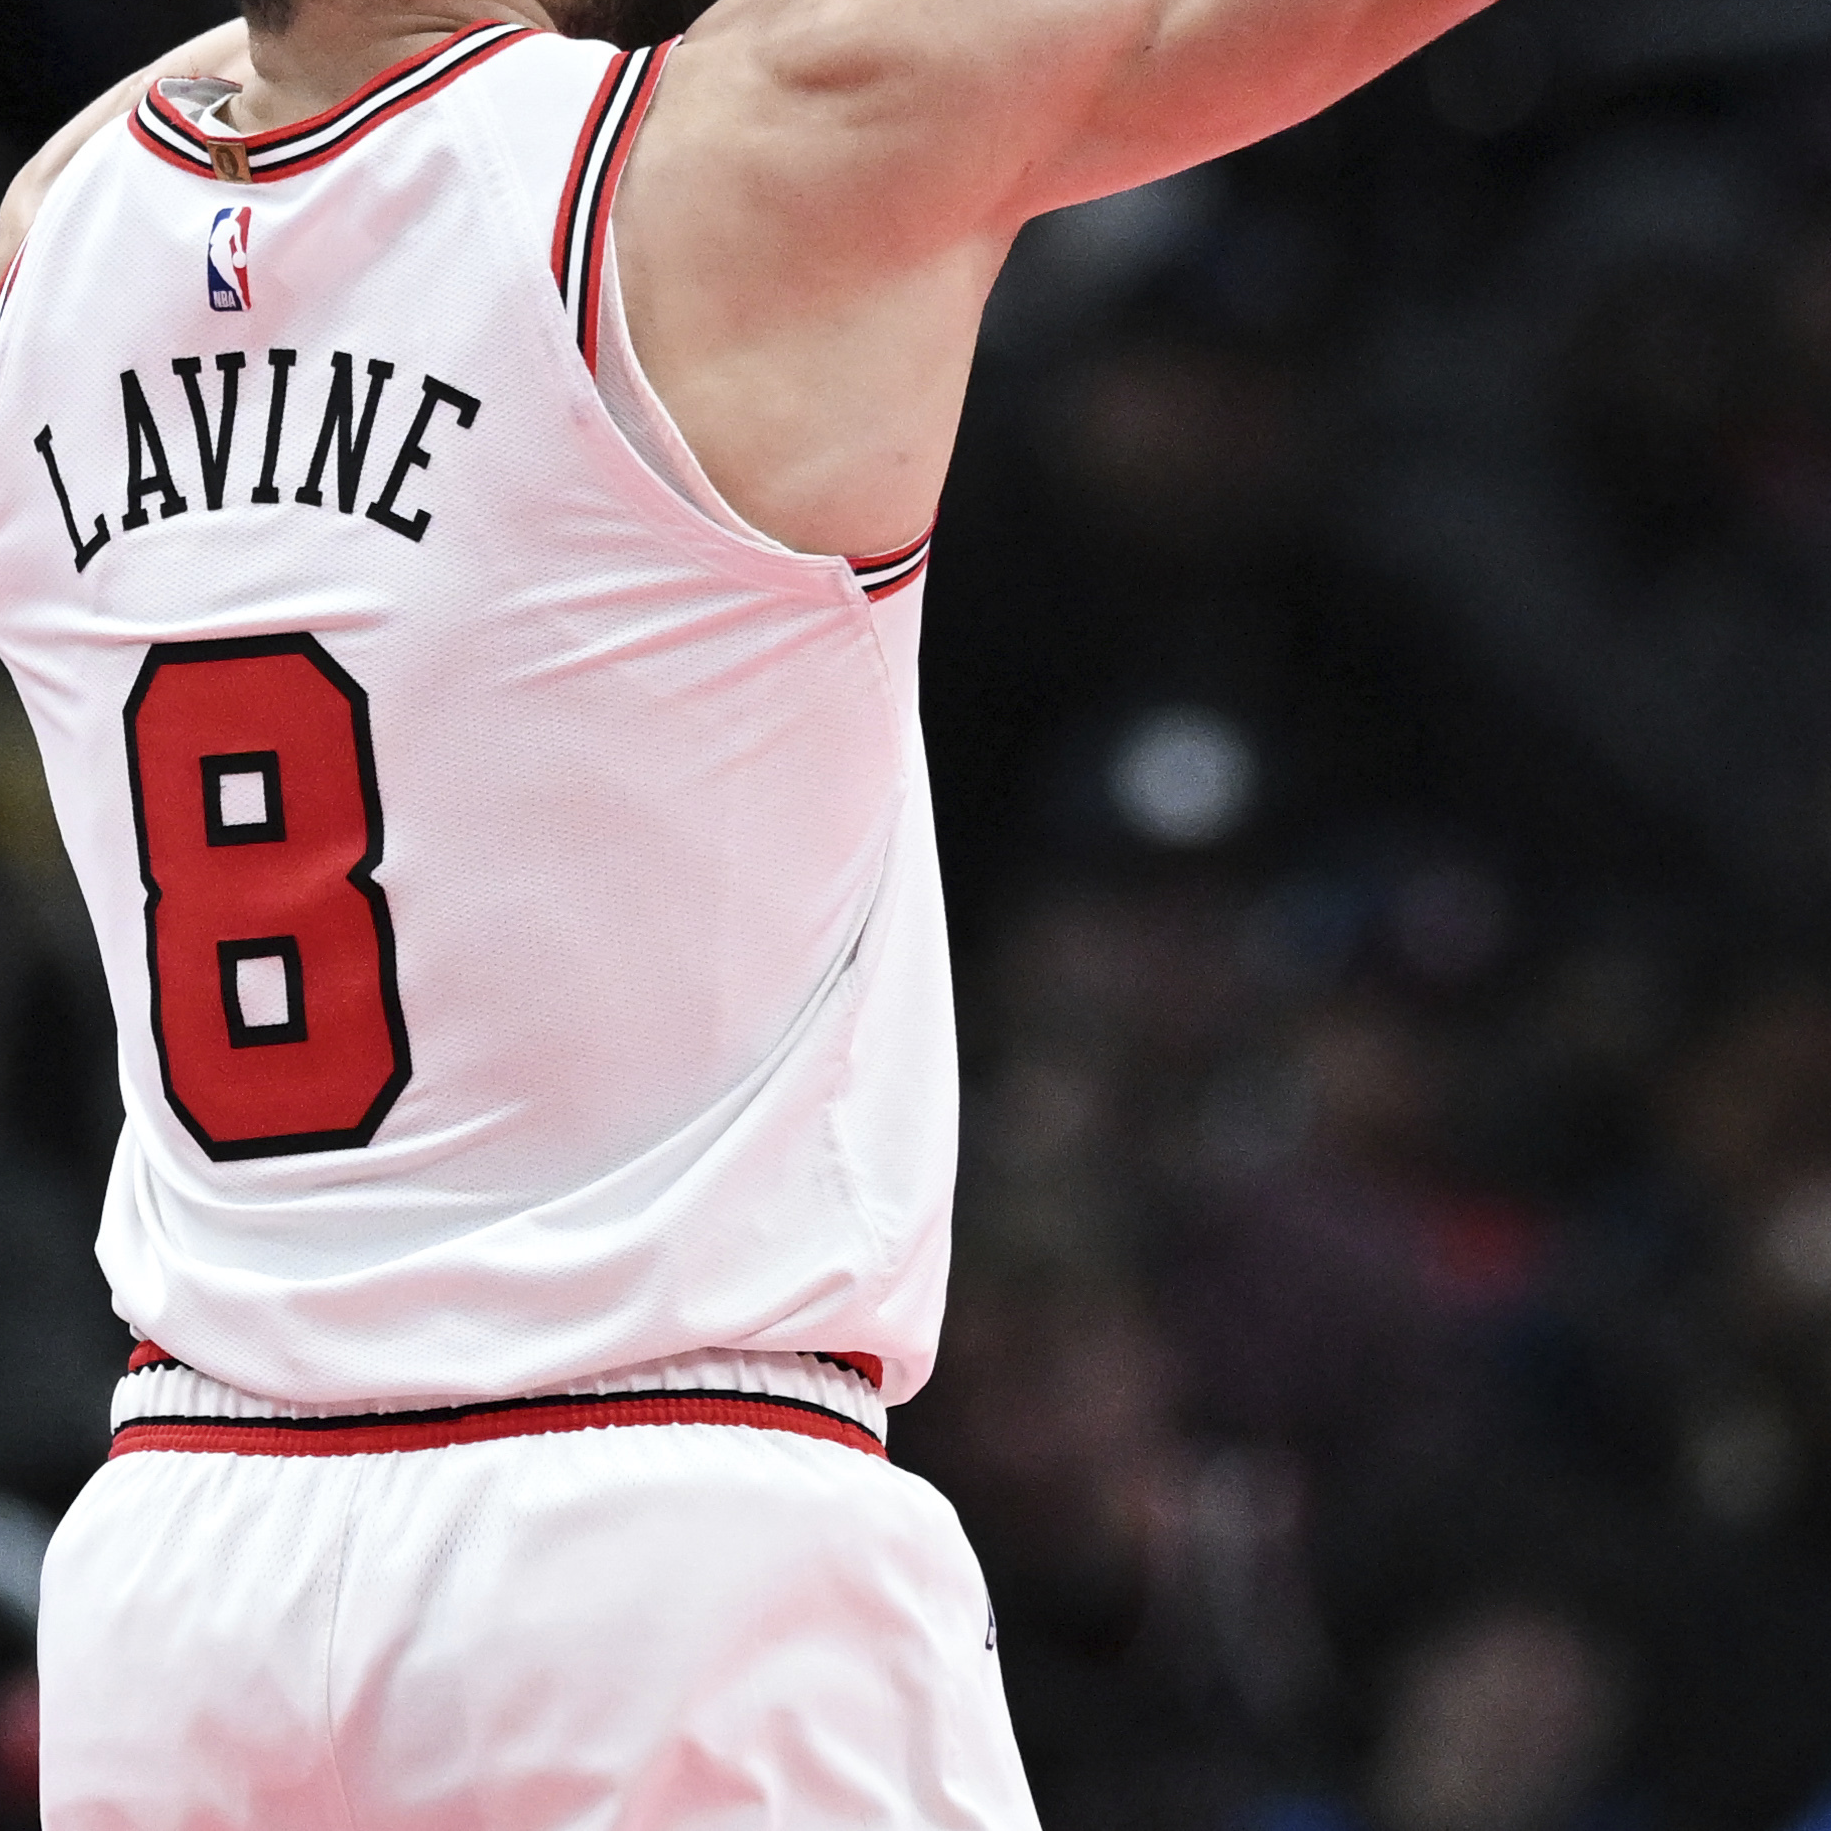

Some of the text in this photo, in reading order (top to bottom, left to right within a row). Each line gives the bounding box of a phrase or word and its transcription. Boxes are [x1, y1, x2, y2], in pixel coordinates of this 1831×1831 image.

[212, 289, 237, 309] NBA
[34, 347, 482, 574] LAVINE
[122, 631, 413, 1163] 8
